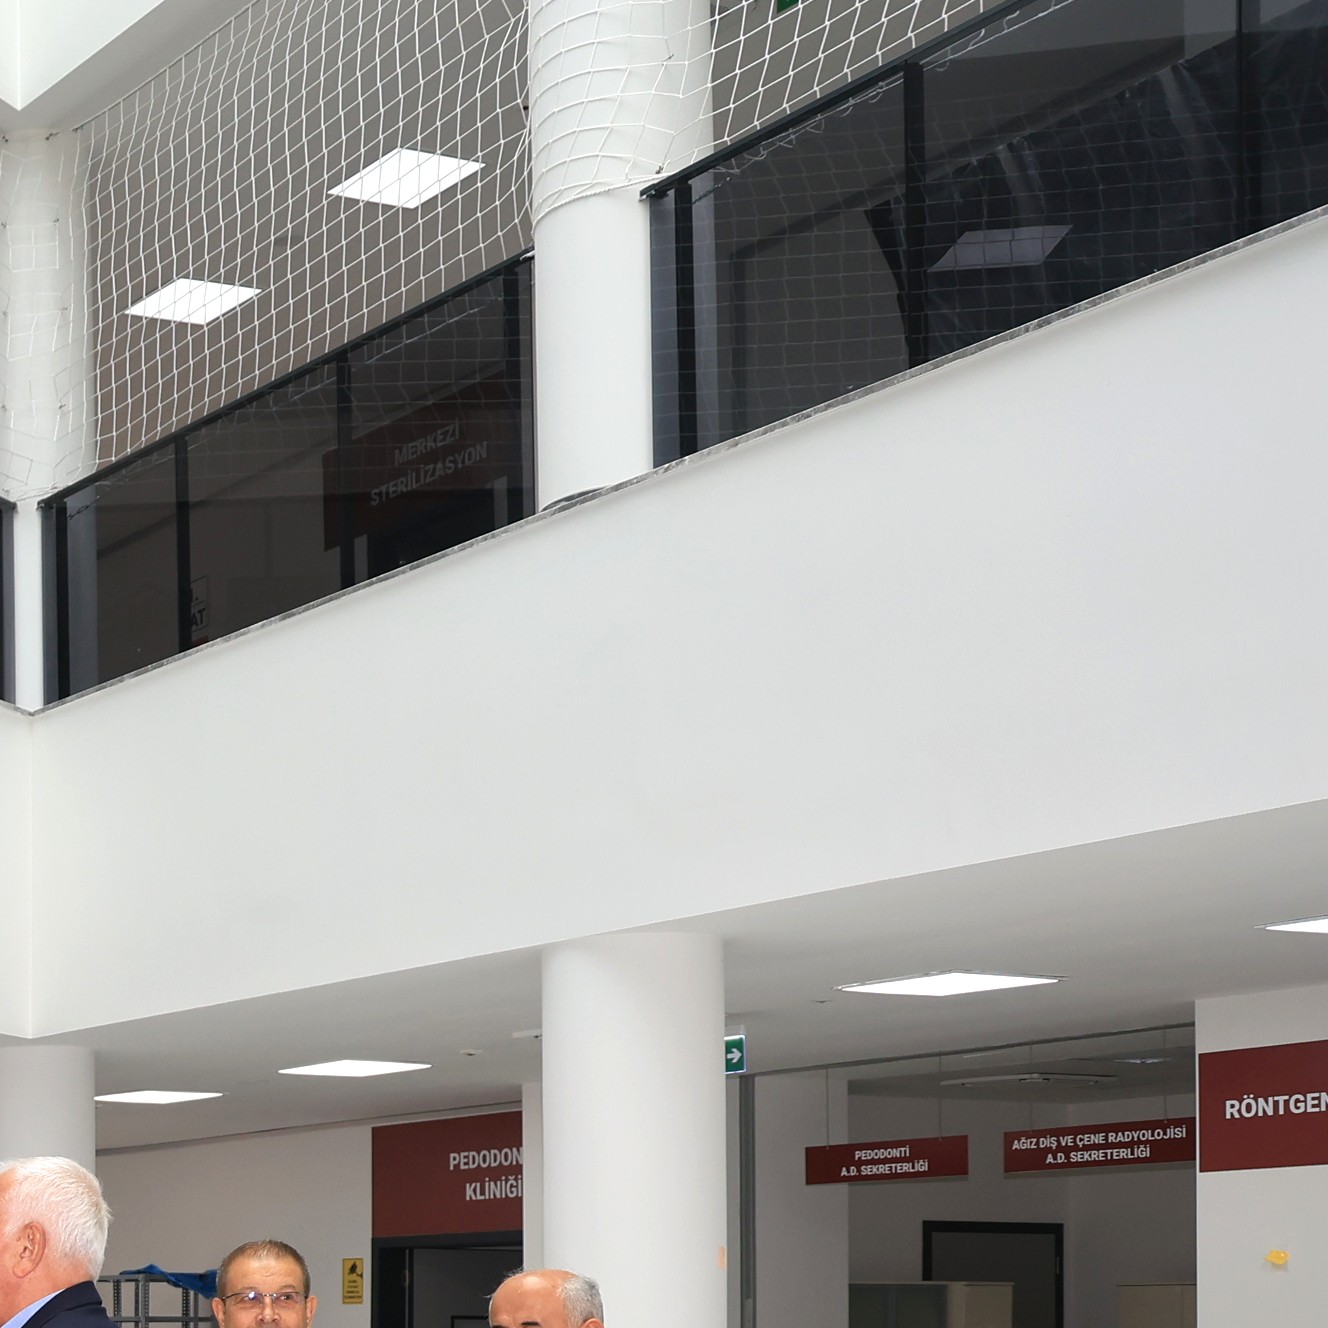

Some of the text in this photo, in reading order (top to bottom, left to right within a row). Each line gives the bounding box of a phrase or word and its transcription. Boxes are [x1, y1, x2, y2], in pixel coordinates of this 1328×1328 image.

[370, 441, 488, 506] STERİLİZASYON
[1011, 1125, 1187, 1150] AĞIZ DİŞ VE ÇENE RADYOLOJİSİ
[854, 1145, 910, 1160] PEDODONTİ
[1045, 1144, 1151, 1164] A.D. SEKRETERLİĞİ
[840, 1159, 929, 1176] A.D. SEKRETERLİĞİ
[465, 1174, 522, 1200] KLİNİĞİ
